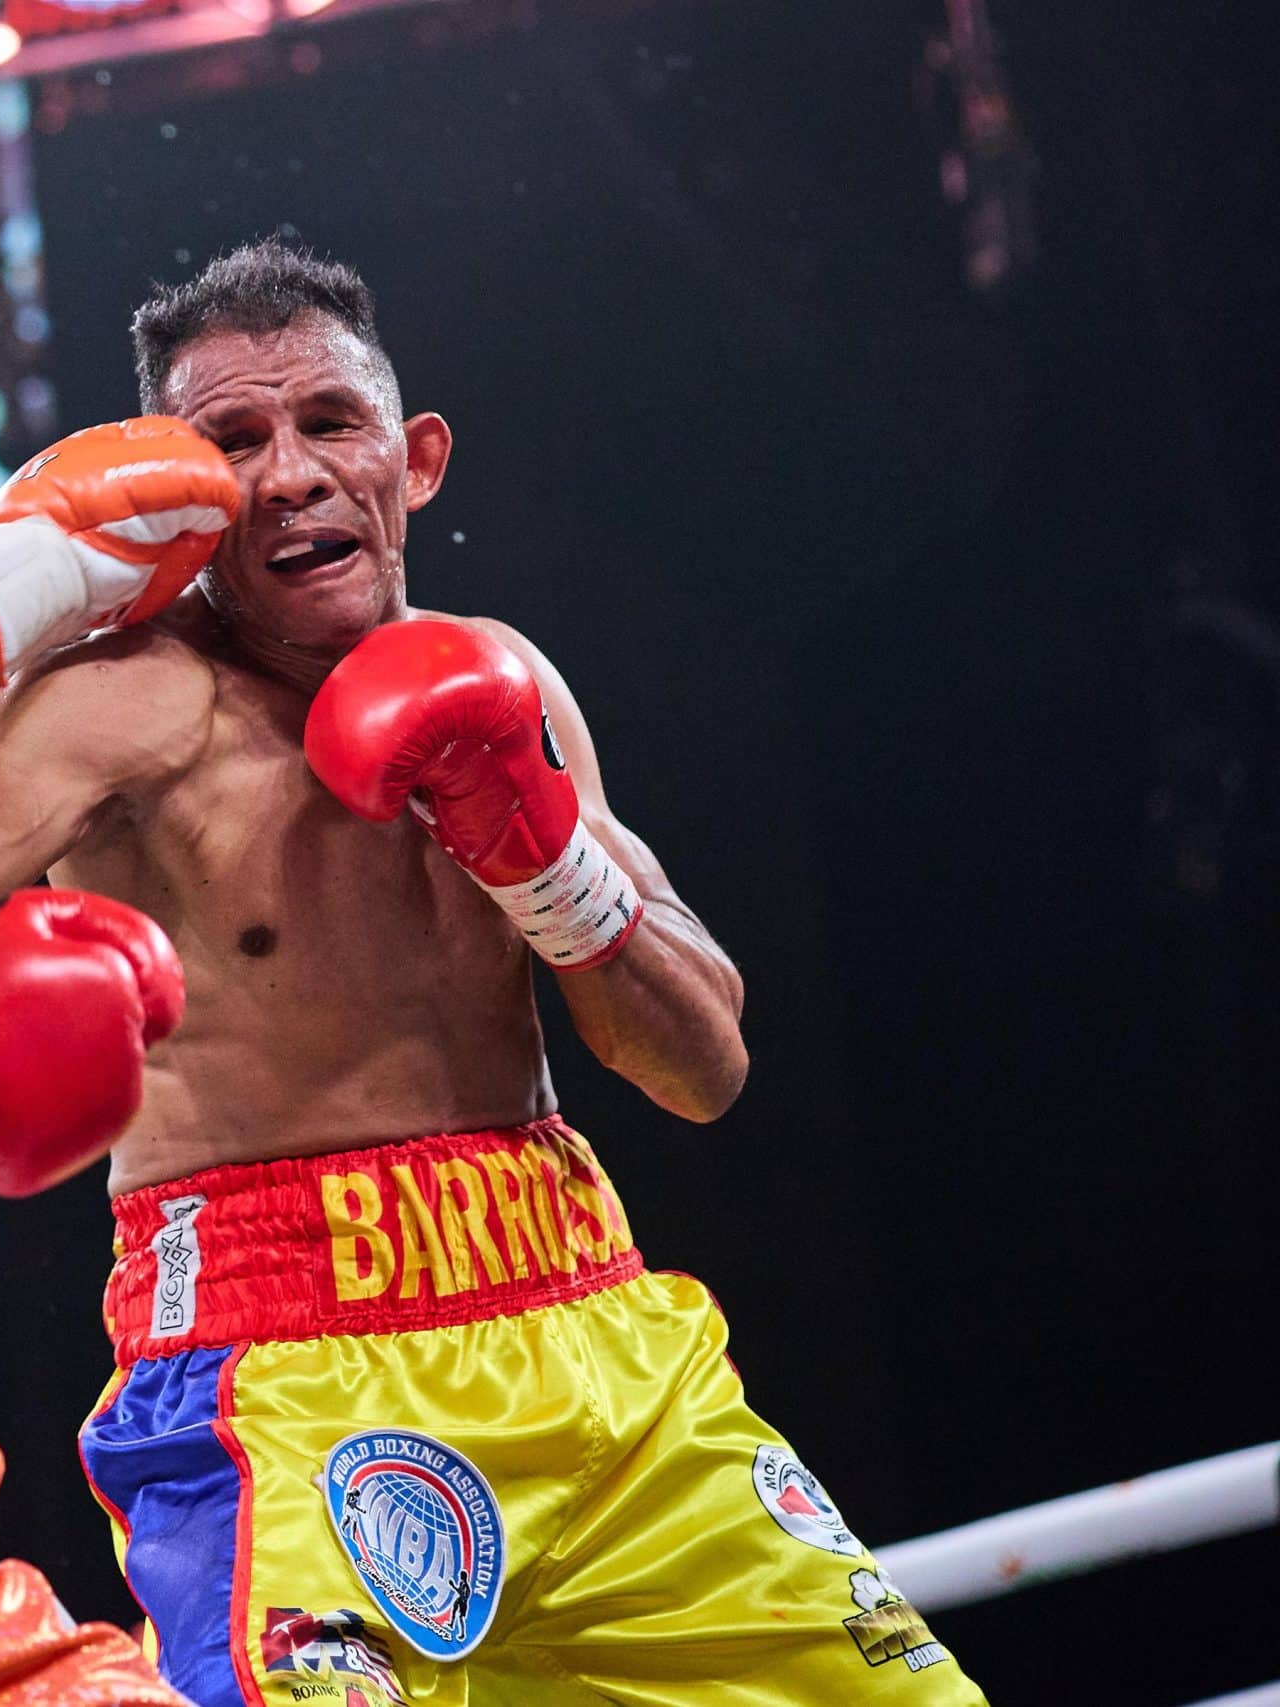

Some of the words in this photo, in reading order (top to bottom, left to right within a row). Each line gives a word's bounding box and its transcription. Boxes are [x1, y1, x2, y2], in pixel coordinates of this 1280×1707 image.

[160, 1202, 201, 1330] BOXX
[331, 1442, 370, 1487] WORLD
[373, 1438, 448, 1470] BOXING
[445, 1466, 495, 1599] ASSOCIATION
[360, 1479, 456, 1608] WBA
[357, 1559, 396, 1597] Simply
[291, 1684, 340, 1702] BOXING
[903, 1643, 949, 1671] BOXI
